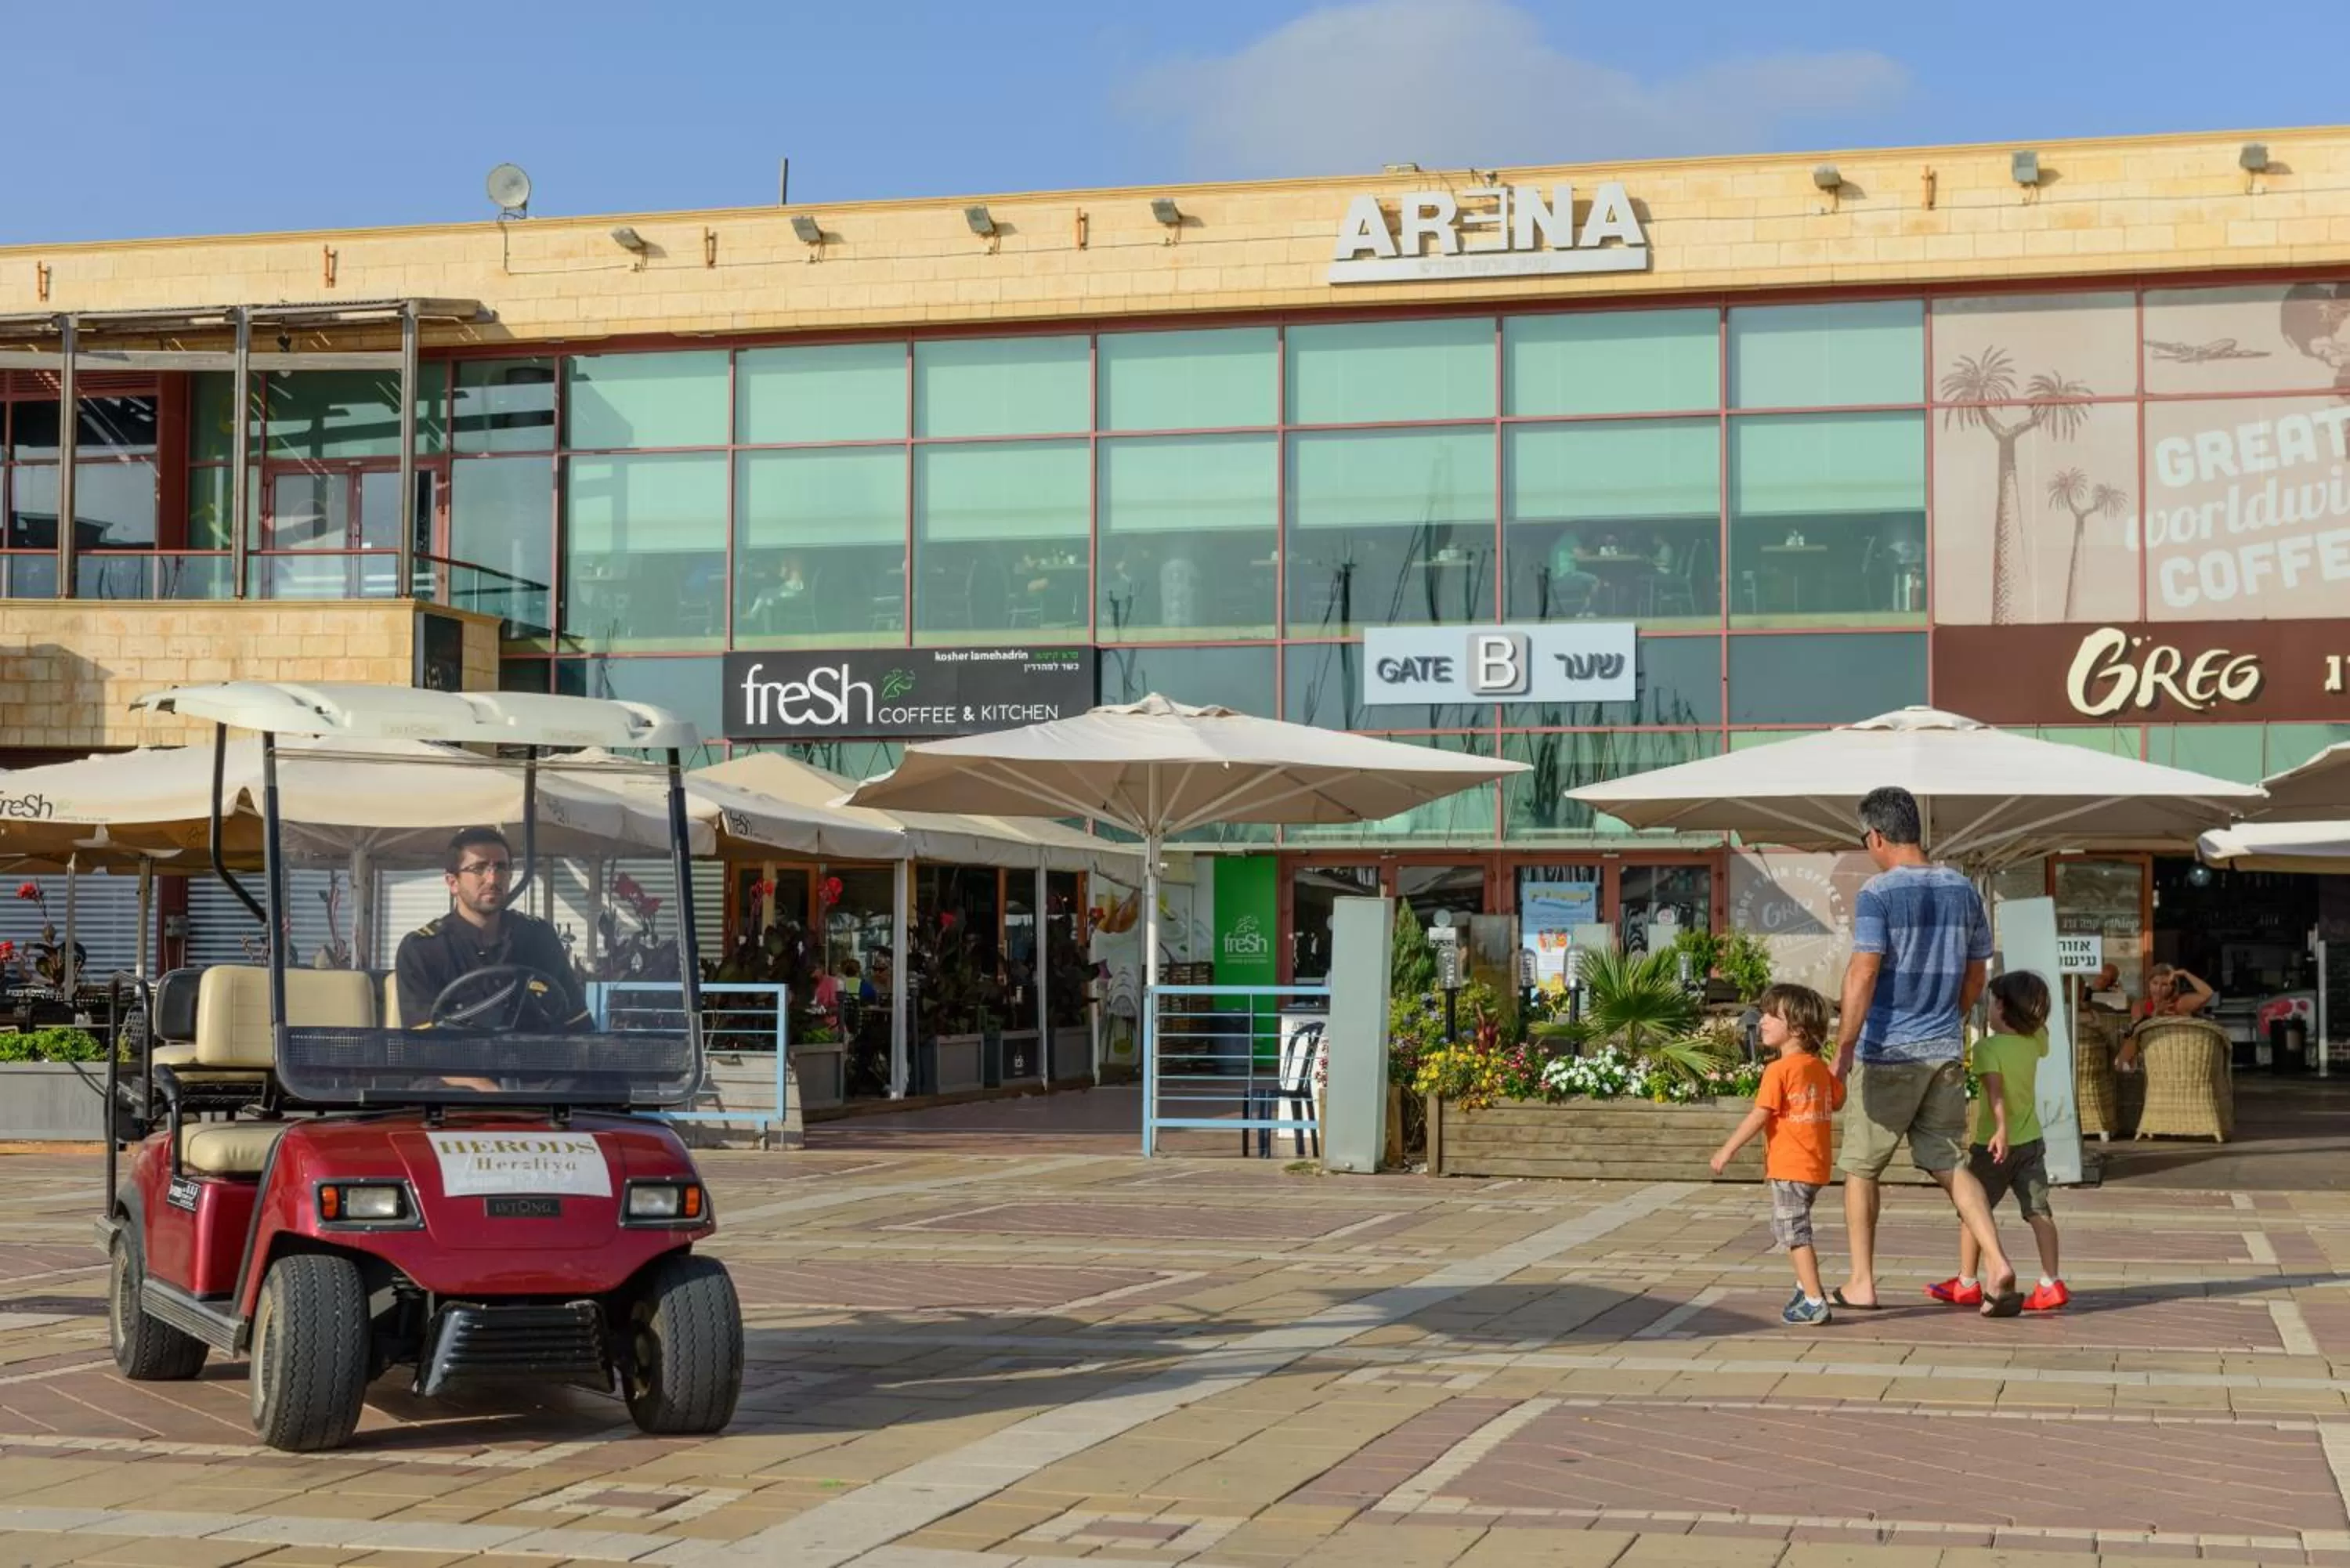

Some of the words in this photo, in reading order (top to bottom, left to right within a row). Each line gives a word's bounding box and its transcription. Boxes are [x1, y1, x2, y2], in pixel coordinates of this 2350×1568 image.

[1333, 182, 1645, 259] ARENA
[2155, 406, 2350, 488] GREAT
[935, 651, 969, 662] kosher
[971, 649, 1029, 661] lamehadrin
[1376, 656, 1454, 684] GATE
[1479, 635, 1517, 689] B
[1062, 663, 1079, 671] כשר
[1554, 652, 1625, 681] שער
[2067, 627, 2260, 717] GREG
[878, 707, 956, 724] COFFEE
[963, 706, 975, 721] &
[981, 703, 1059, 721] KITCHEN
[2059, 940, 2091, 952] אזור
[439, 1140, 597, 1154] HERODS
[477, 1157, 577, 1172] Herzliya
